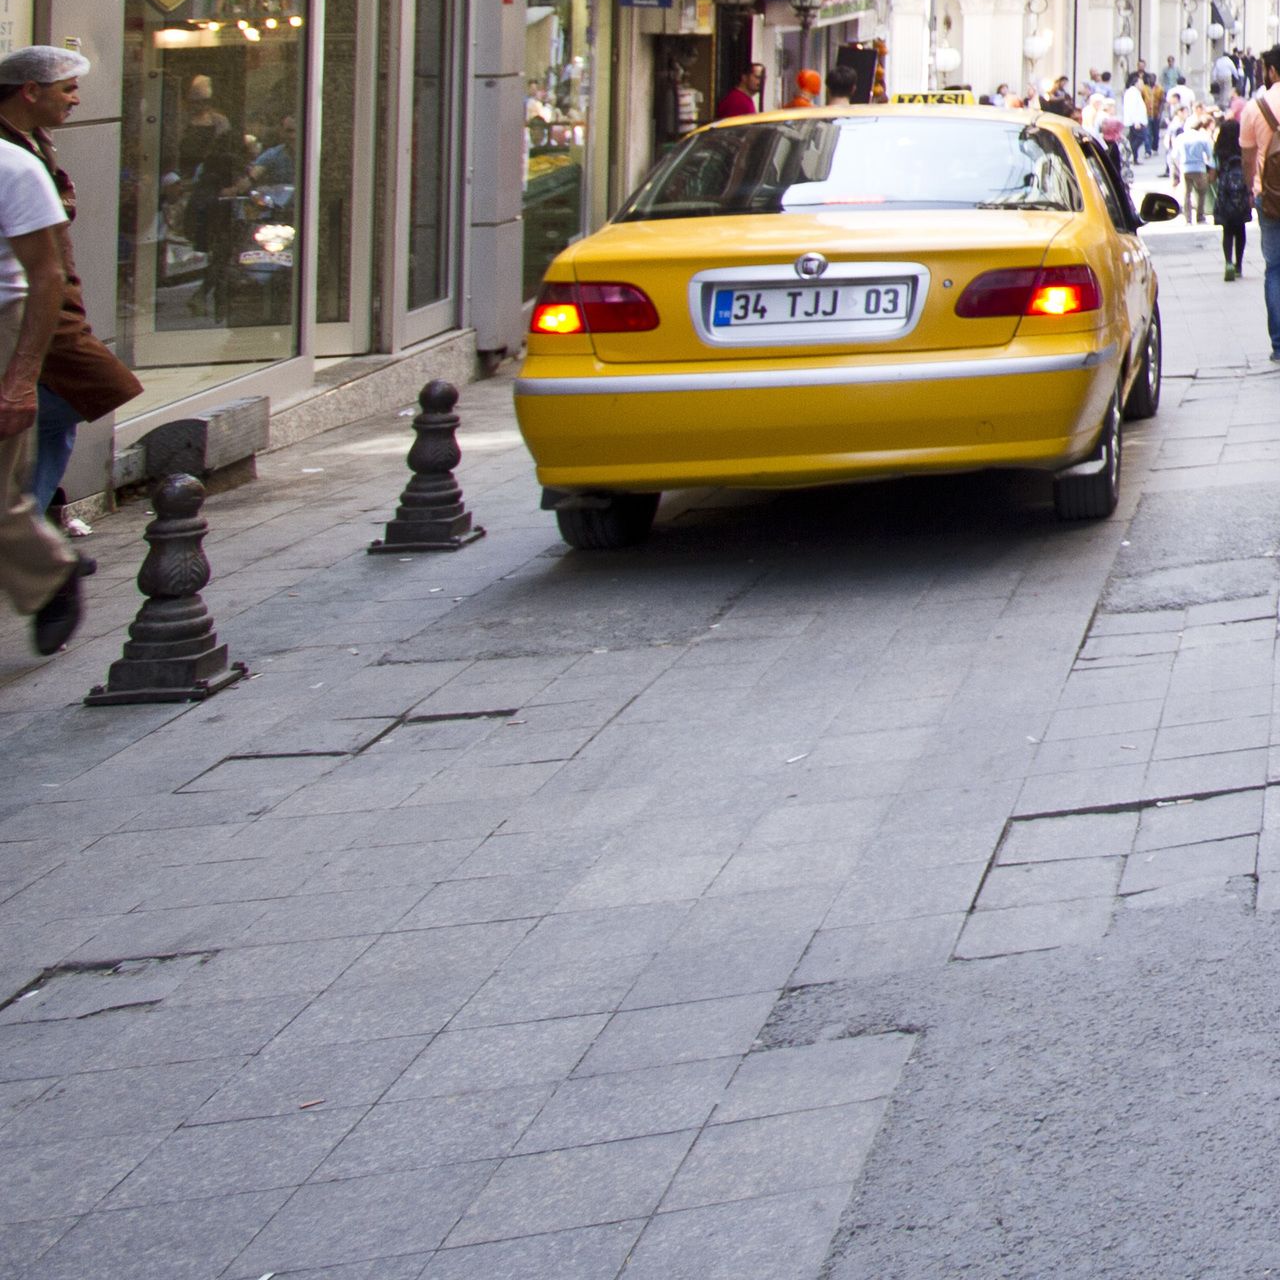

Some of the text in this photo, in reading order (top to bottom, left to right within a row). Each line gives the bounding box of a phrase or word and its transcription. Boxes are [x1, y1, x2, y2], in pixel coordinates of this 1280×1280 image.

[733, 287, 900, 321] 34 TJJ 03
